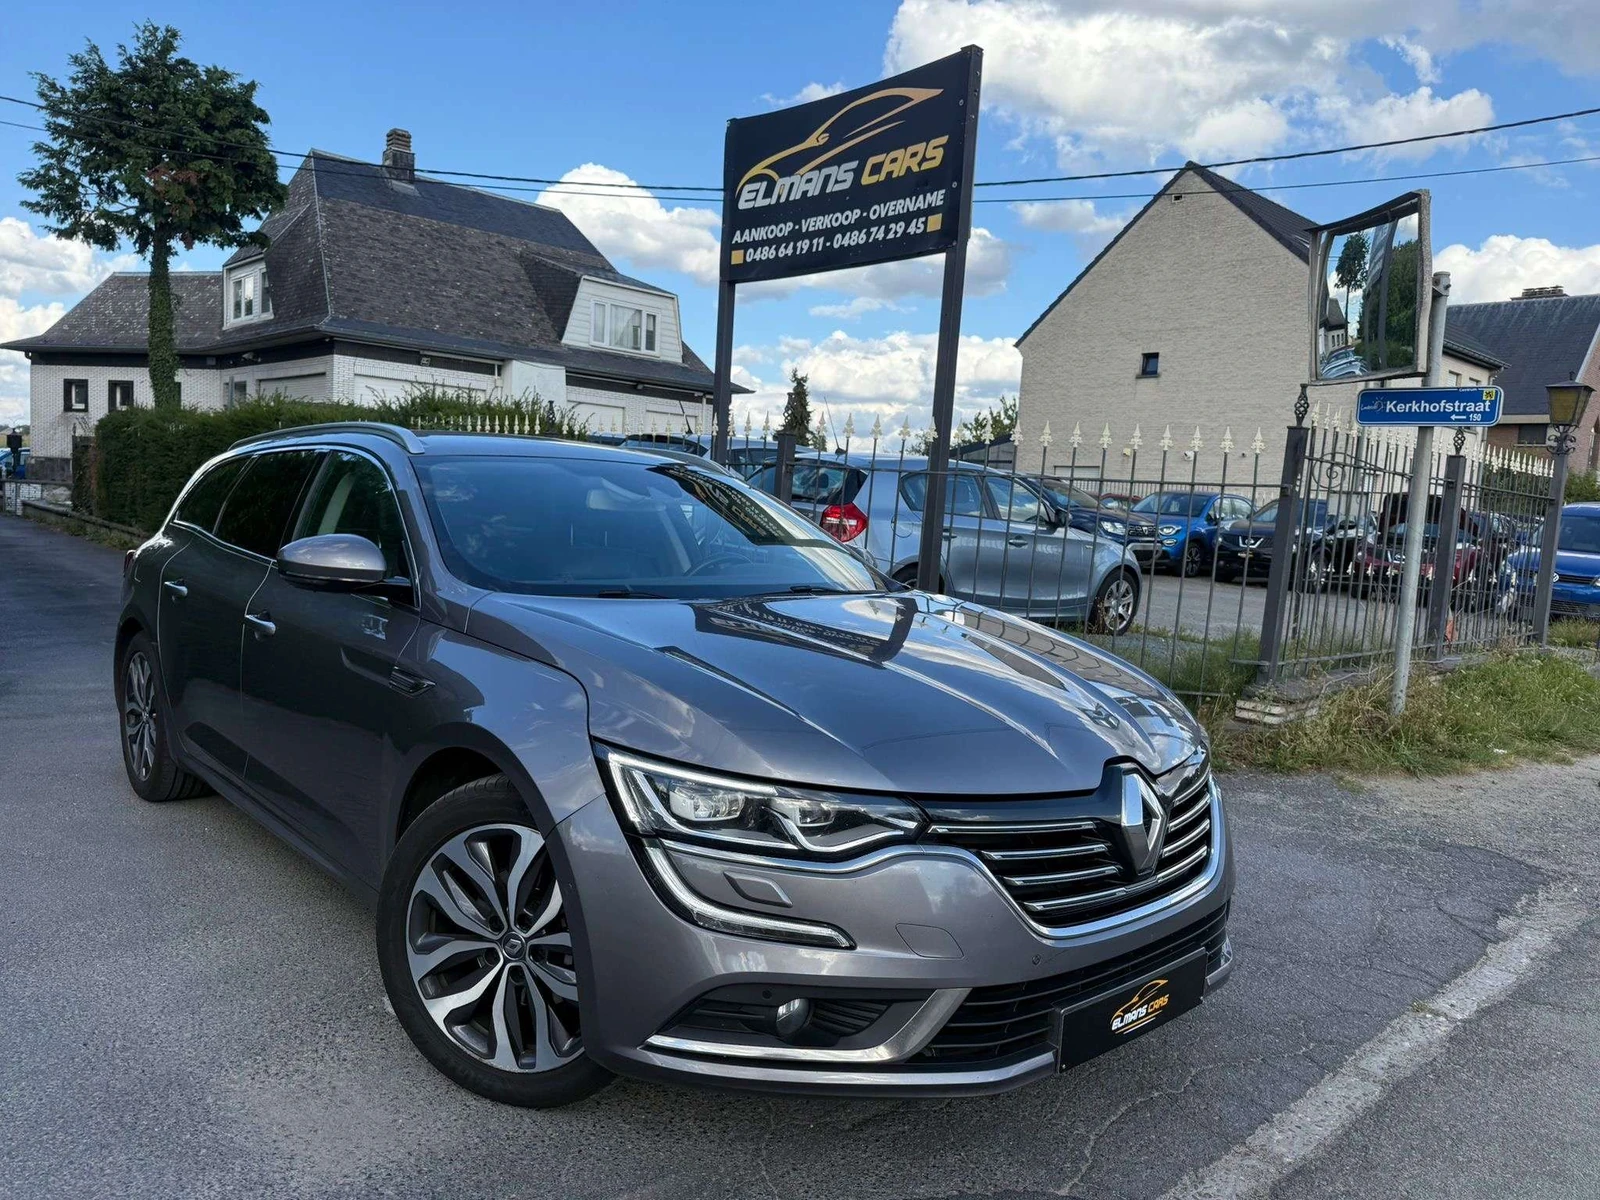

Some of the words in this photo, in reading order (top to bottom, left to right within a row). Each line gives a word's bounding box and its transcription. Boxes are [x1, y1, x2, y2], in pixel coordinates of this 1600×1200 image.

[860, 135, 949, 186] CARS
[732, 221, 794, 244] AANKOOP
[801, 208, 861, 233] VERKOOP
[869, 189, 946, 220] OVERNAME
[745, 245, 776, 263] 0486
[777, 241, 794, 258] 64
[797, 239, 810, 255] 19
[811, 236, 824, 252] 11
[833, 228, 867, 249] 0486
[869, 225, 886, 243] 74
[886, 221, 905, 240] 29
[906, 217, 925, 236] 45
[1386, 399, 1491, 413] Kerkhofstraat
[1469, 413, 1481, 421] 150
[1148, 994, 1170, 1013] CARS
